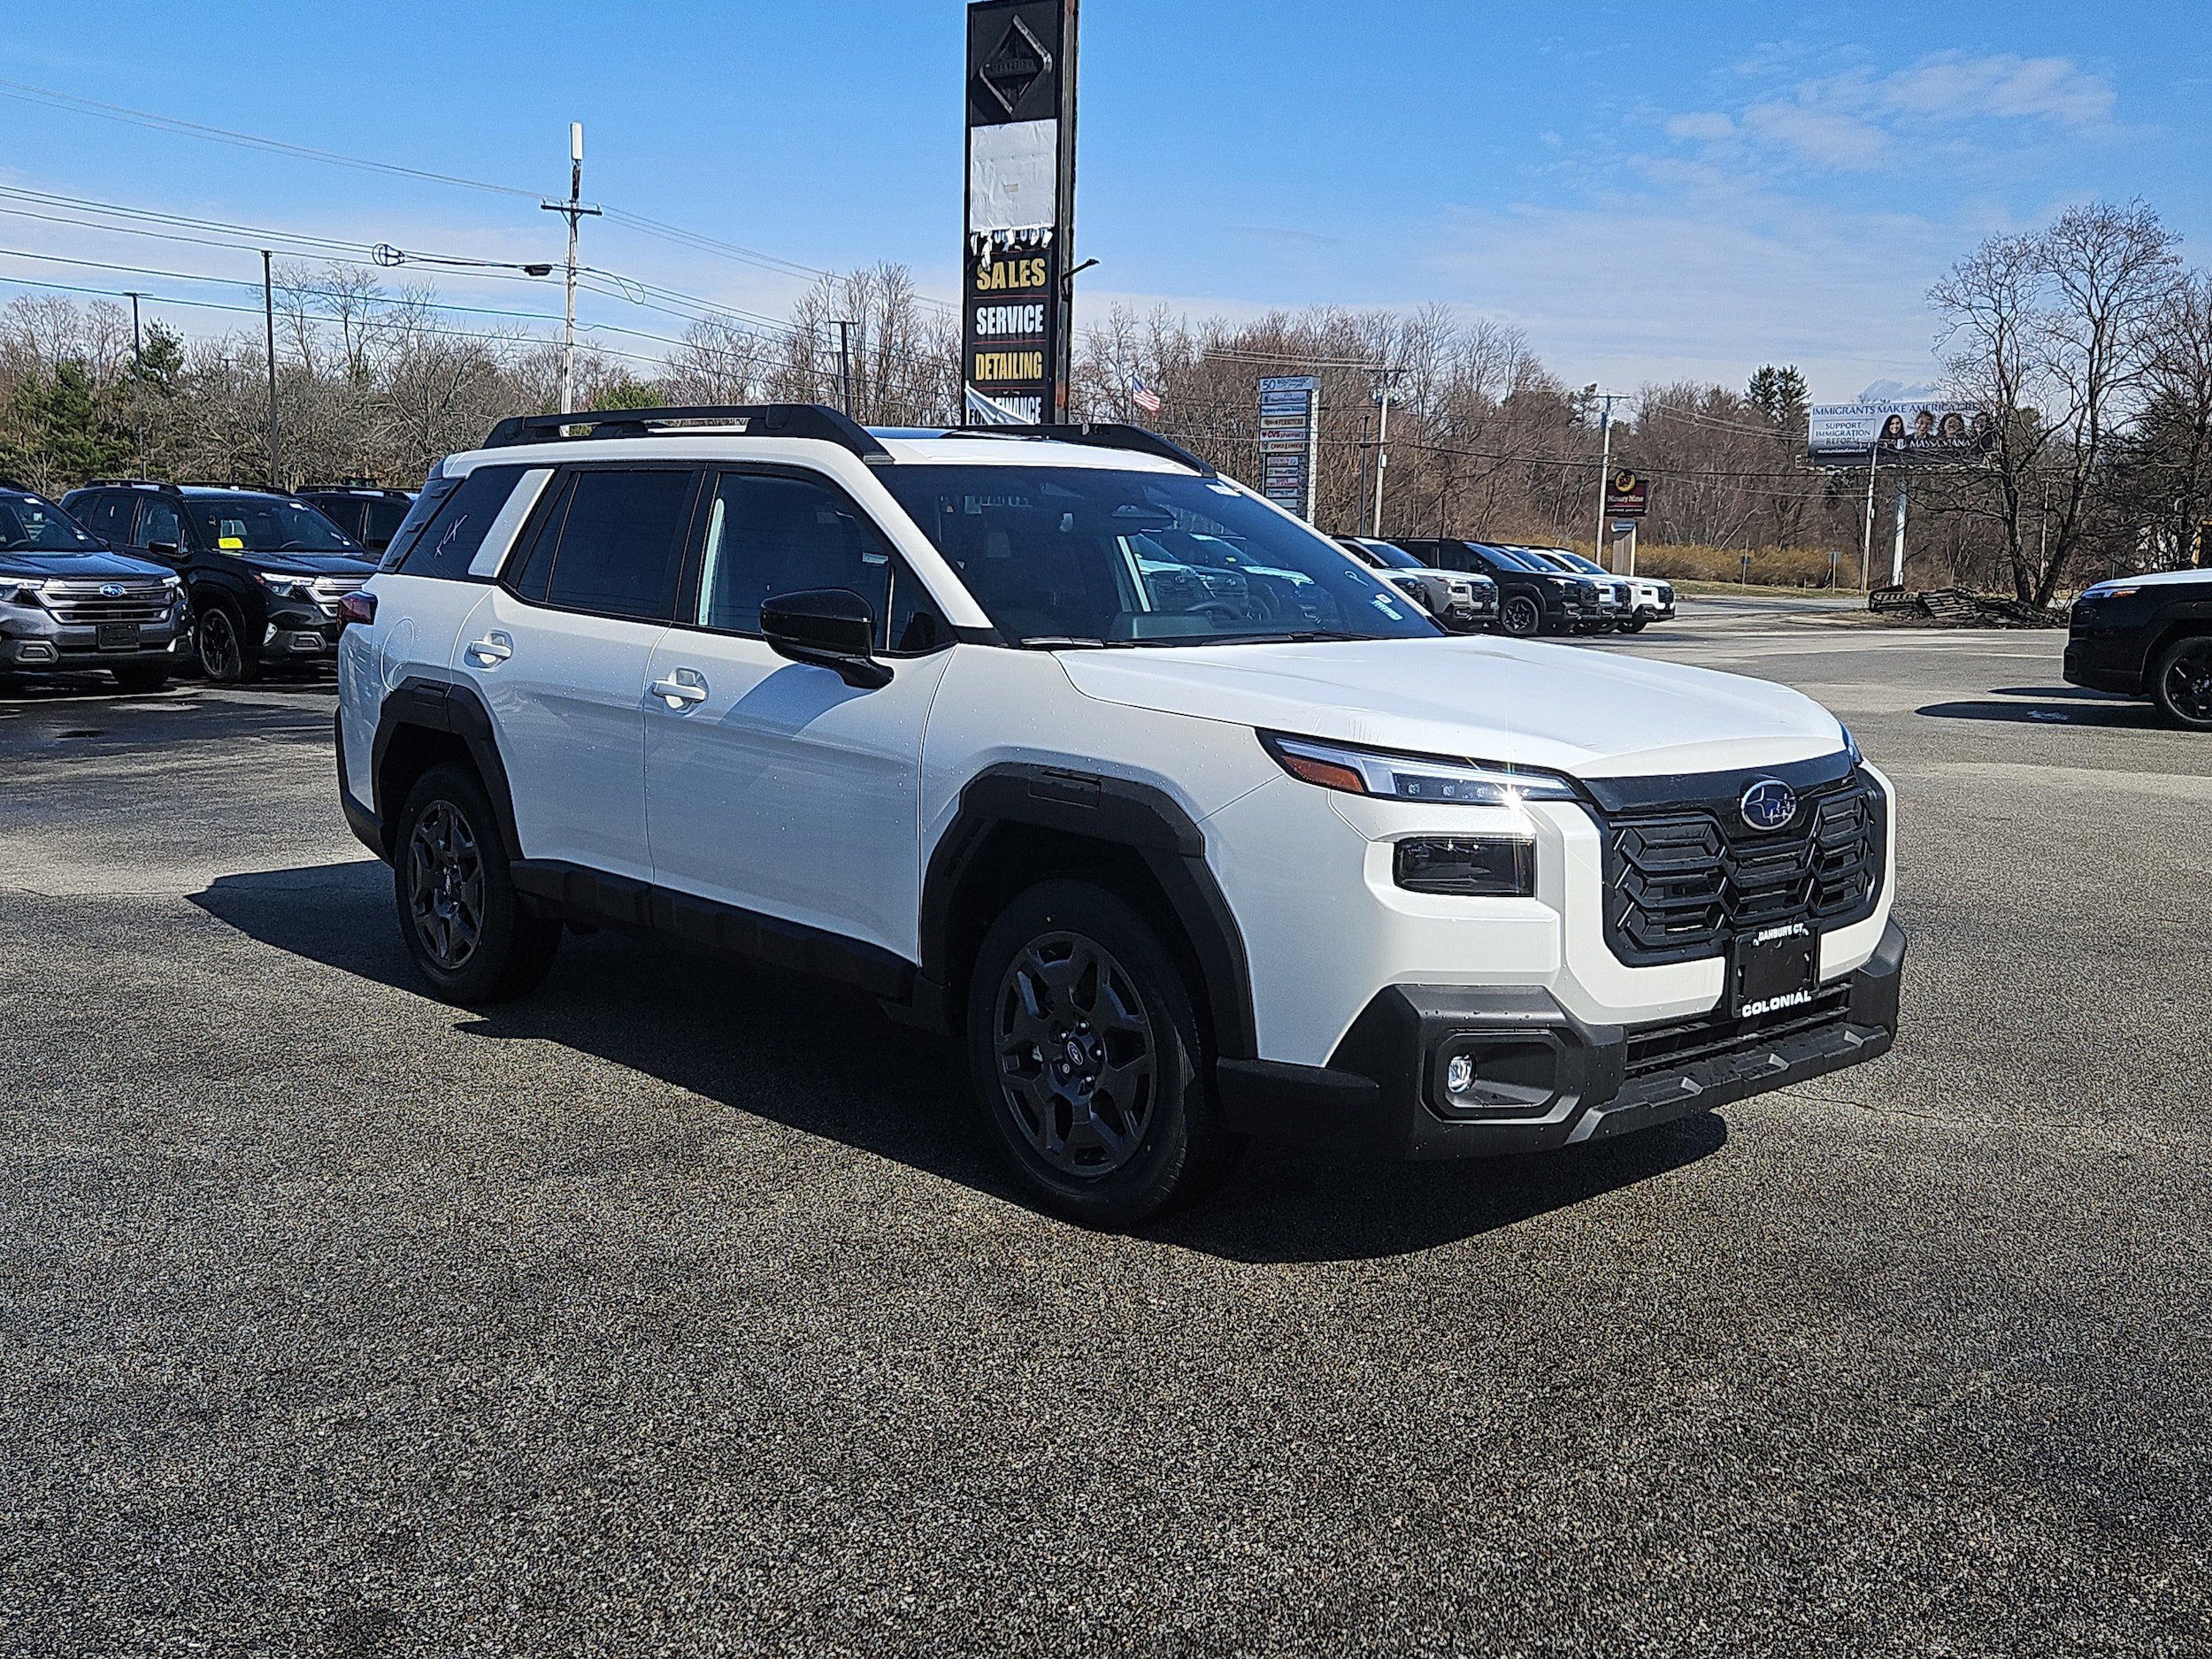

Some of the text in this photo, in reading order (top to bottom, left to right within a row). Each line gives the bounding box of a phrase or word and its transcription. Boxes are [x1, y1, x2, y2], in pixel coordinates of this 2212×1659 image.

[977, 257, 1046, 290] SALES
[976, 304, 1044, 335] SERVICE
[975, 351, 1042, 380] DETAILING
[1263, 380, 1276, 390] 50
[995, 396, 1042, 425] NANCE
[1812, 405, 1875, 416] IMMIGRANTS
[1877, 404, 1907, 414] MAKE
[1909, 403, 1954, 413] AMERICA
[1757, 923, 1804, 941] DANBURY CT
[1741, 989, 1812, 1018] COLONIAL
